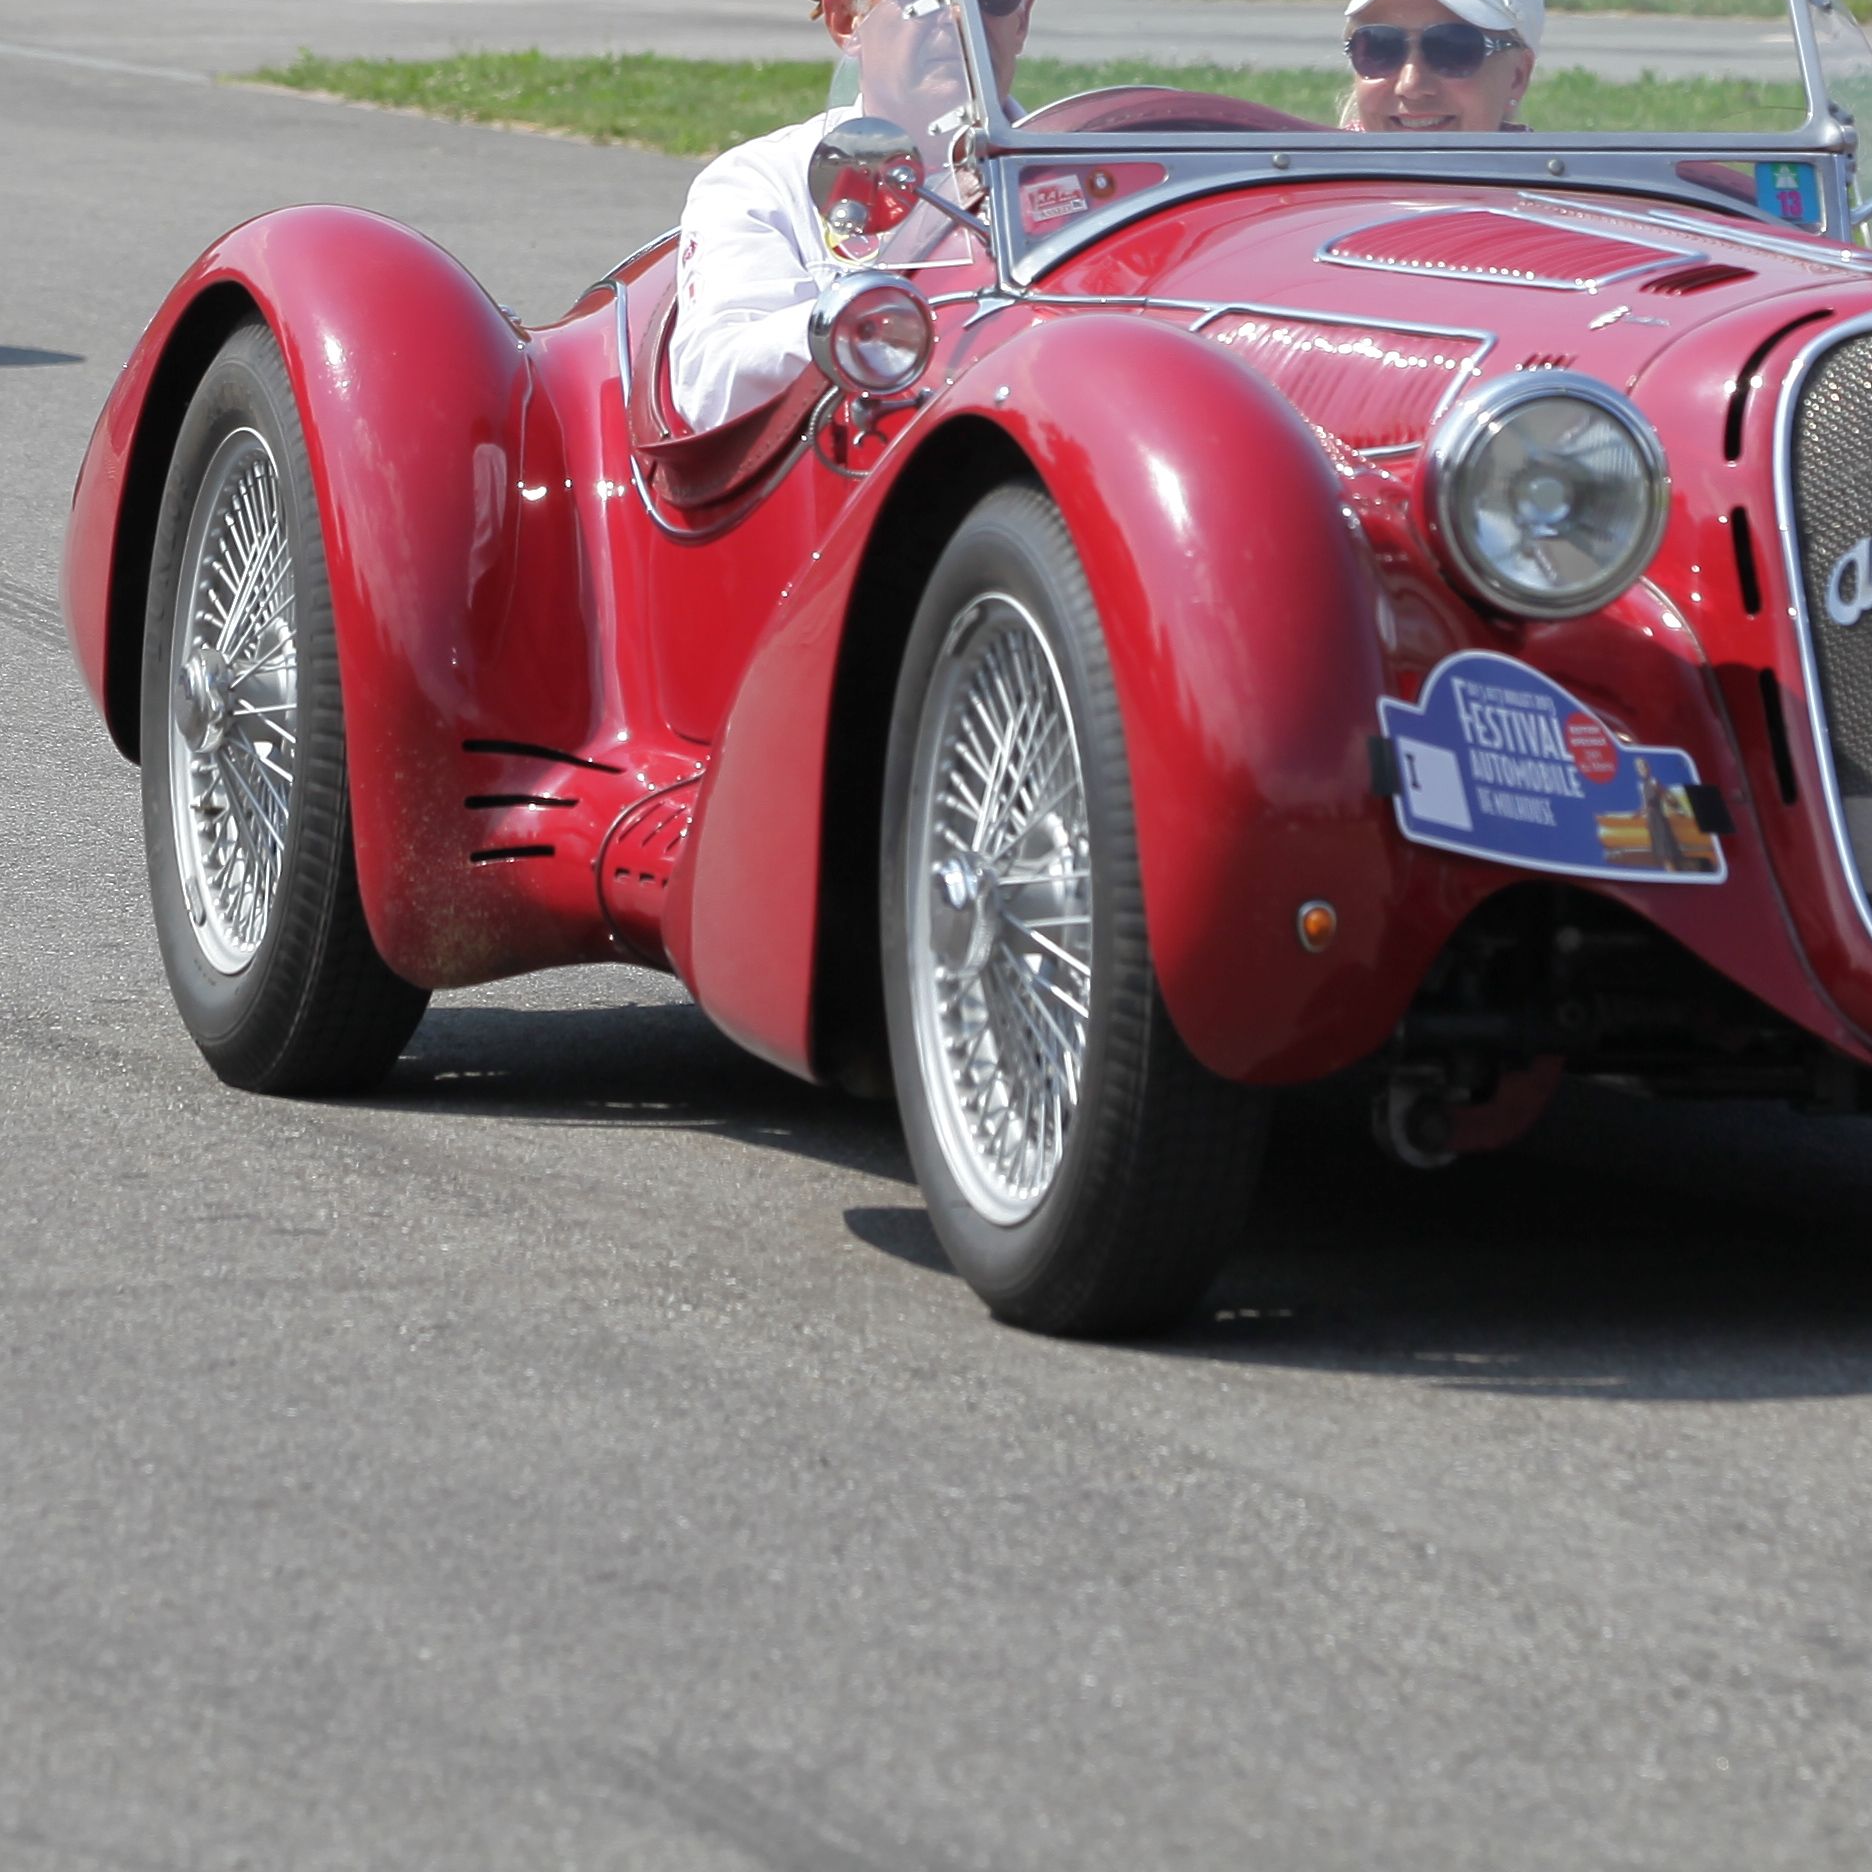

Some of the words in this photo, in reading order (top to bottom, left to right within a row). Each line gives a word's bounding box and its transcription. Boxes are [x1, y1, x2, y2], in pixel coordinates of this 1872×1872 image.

[1777, 190, 1803, 217] 13
[1450, 676, 1576, 763] FESTIVAL
[1469, 747, 1586, 799] AUTOMOBILE
